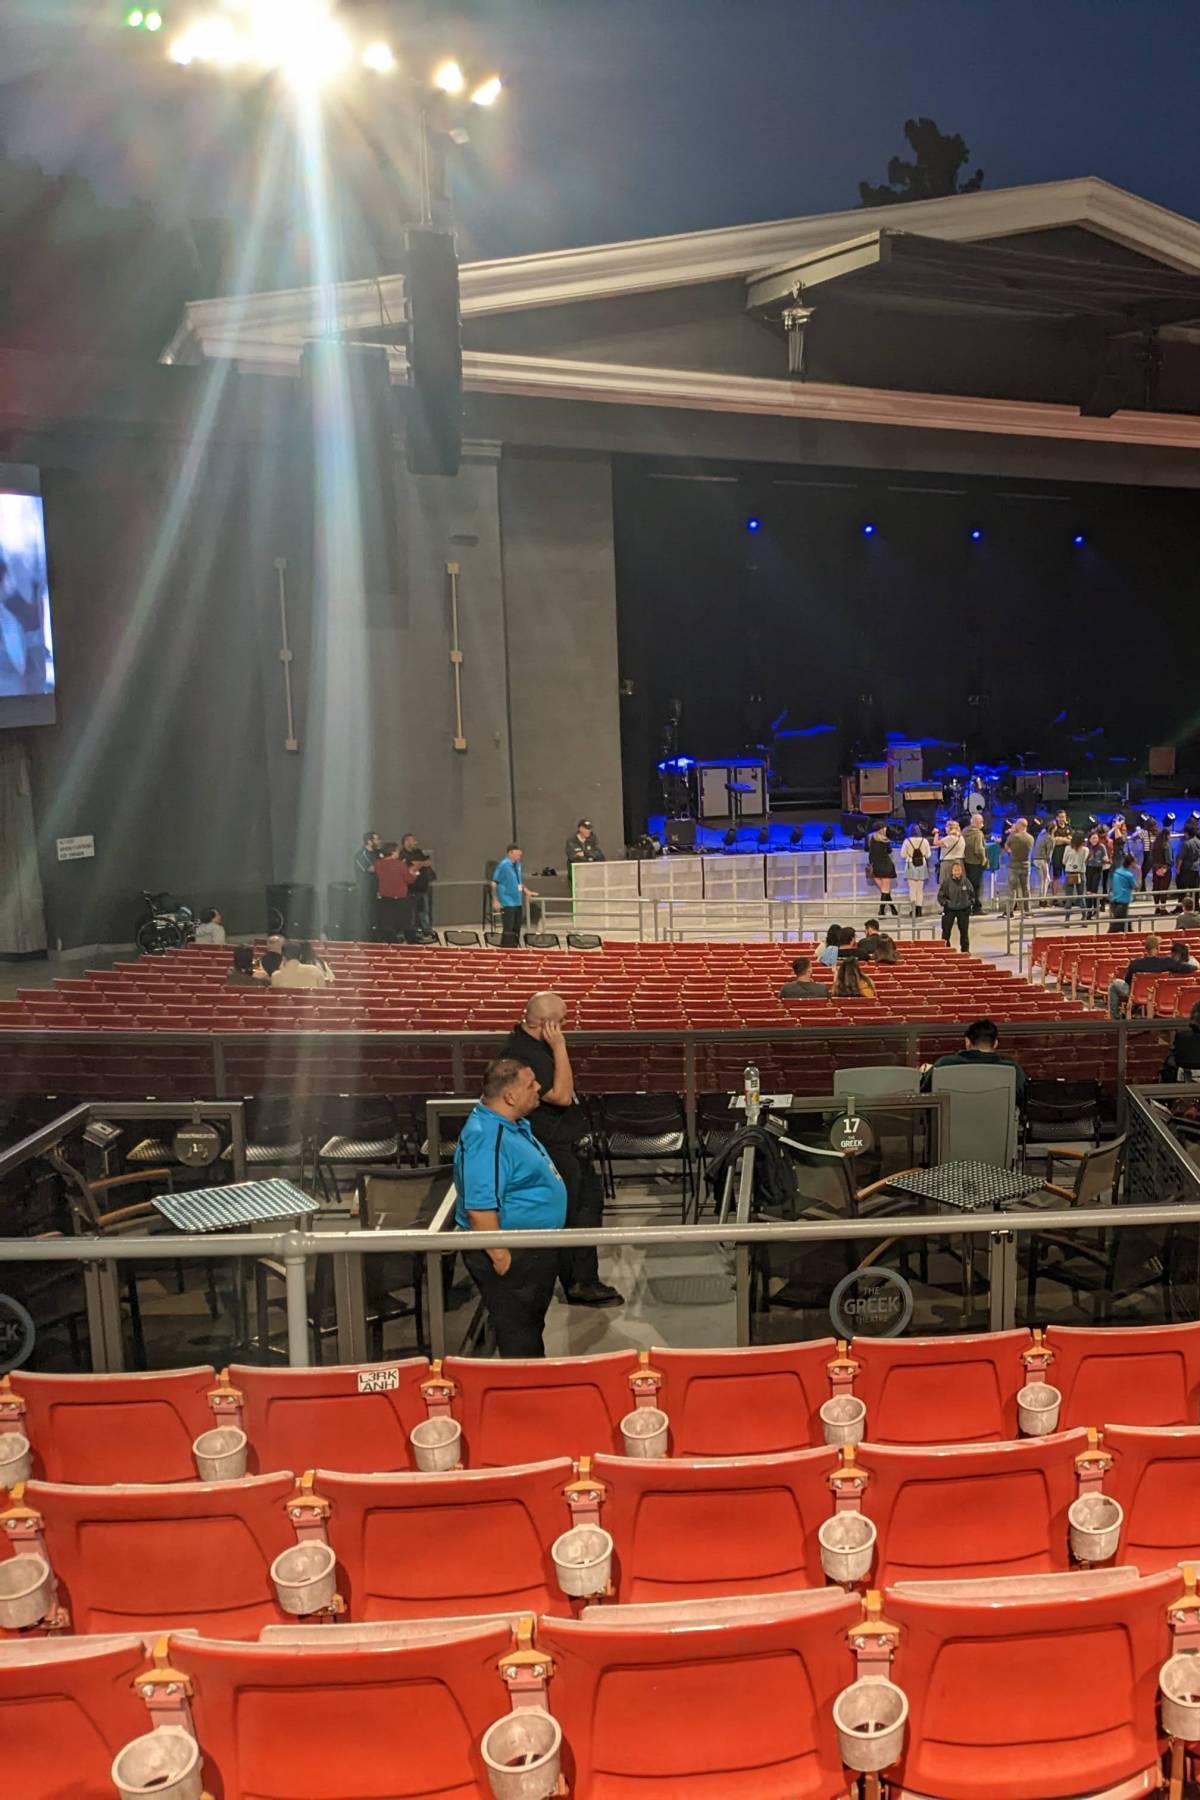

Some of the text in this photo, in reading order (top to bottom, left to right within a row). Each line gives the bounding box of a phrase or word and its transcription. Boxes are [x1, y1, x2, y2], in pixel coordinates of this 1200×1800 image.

[843, 1118, 860, 1133] 17
[840, 1139, 864, 1148] GREEK
[863, 1286, 880, 1295] THE
[843, 1296, 900, 1315] GREEK
[362, 1380, 394, 1392] ANH
